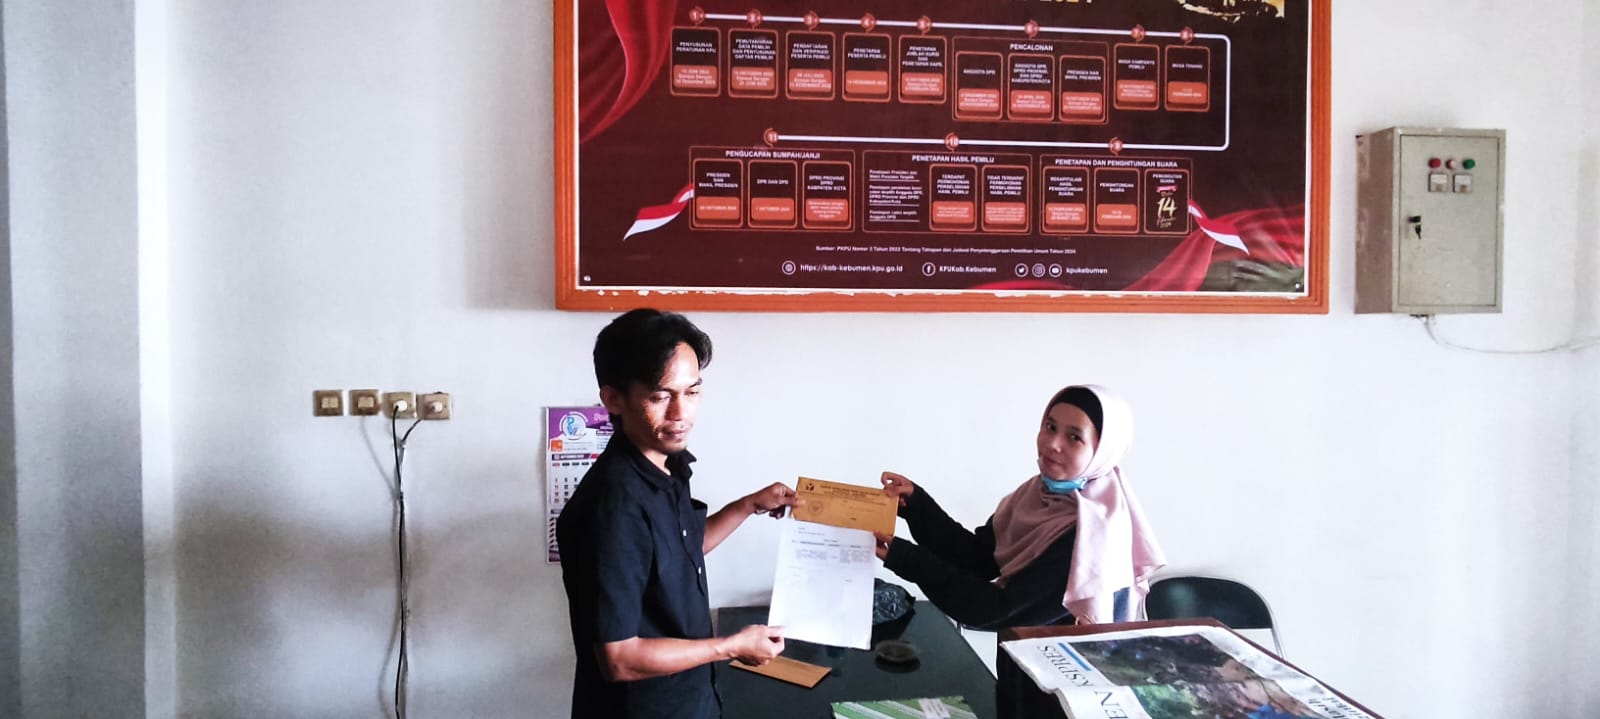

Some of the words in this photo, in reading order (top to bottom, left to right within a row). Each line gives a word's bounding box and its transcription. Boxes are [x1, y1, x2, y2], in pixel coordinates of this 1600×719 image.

[1010, 43, 1054, 51] PENCALONAN
[725, 150, 772, 158] PENGUCAPAN
[772, 151, 821, 159] SUMPAH/JANJI
[1055, 158, 1092, 166] PENETAPAN
[1156, 197, 1177, 218] 14
[800, 264, 903, 273] https://kab-kebumen.kpu.go.id
[1065, 267, 1108, 275] kpukebumen
